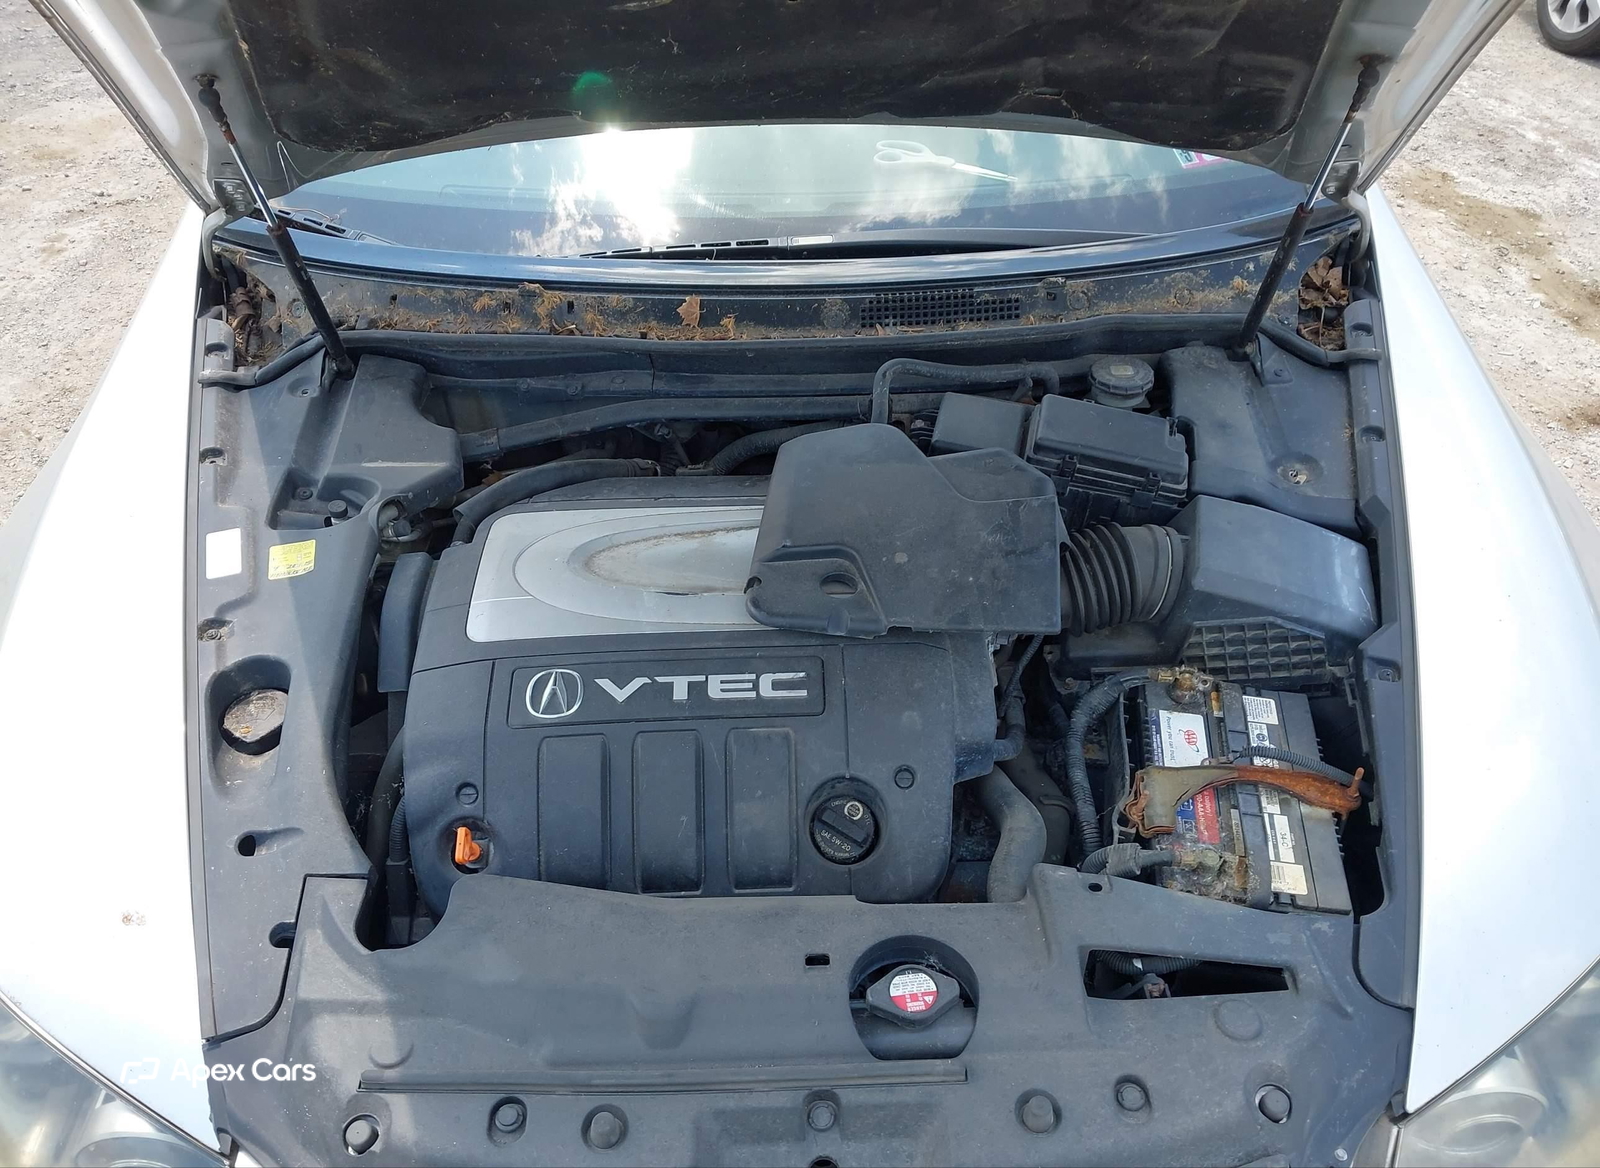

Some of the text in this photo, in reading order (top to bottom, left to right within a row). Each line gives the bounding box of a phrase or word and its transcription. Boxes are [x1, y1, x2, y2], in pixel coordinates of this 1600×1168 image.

[593, 671, 808, 703] VTEC
[820, 829, 832, 840] SAE
[831, 835, 852, 852] 5W-20
[1279, 832, 1289, 848] 34-C
